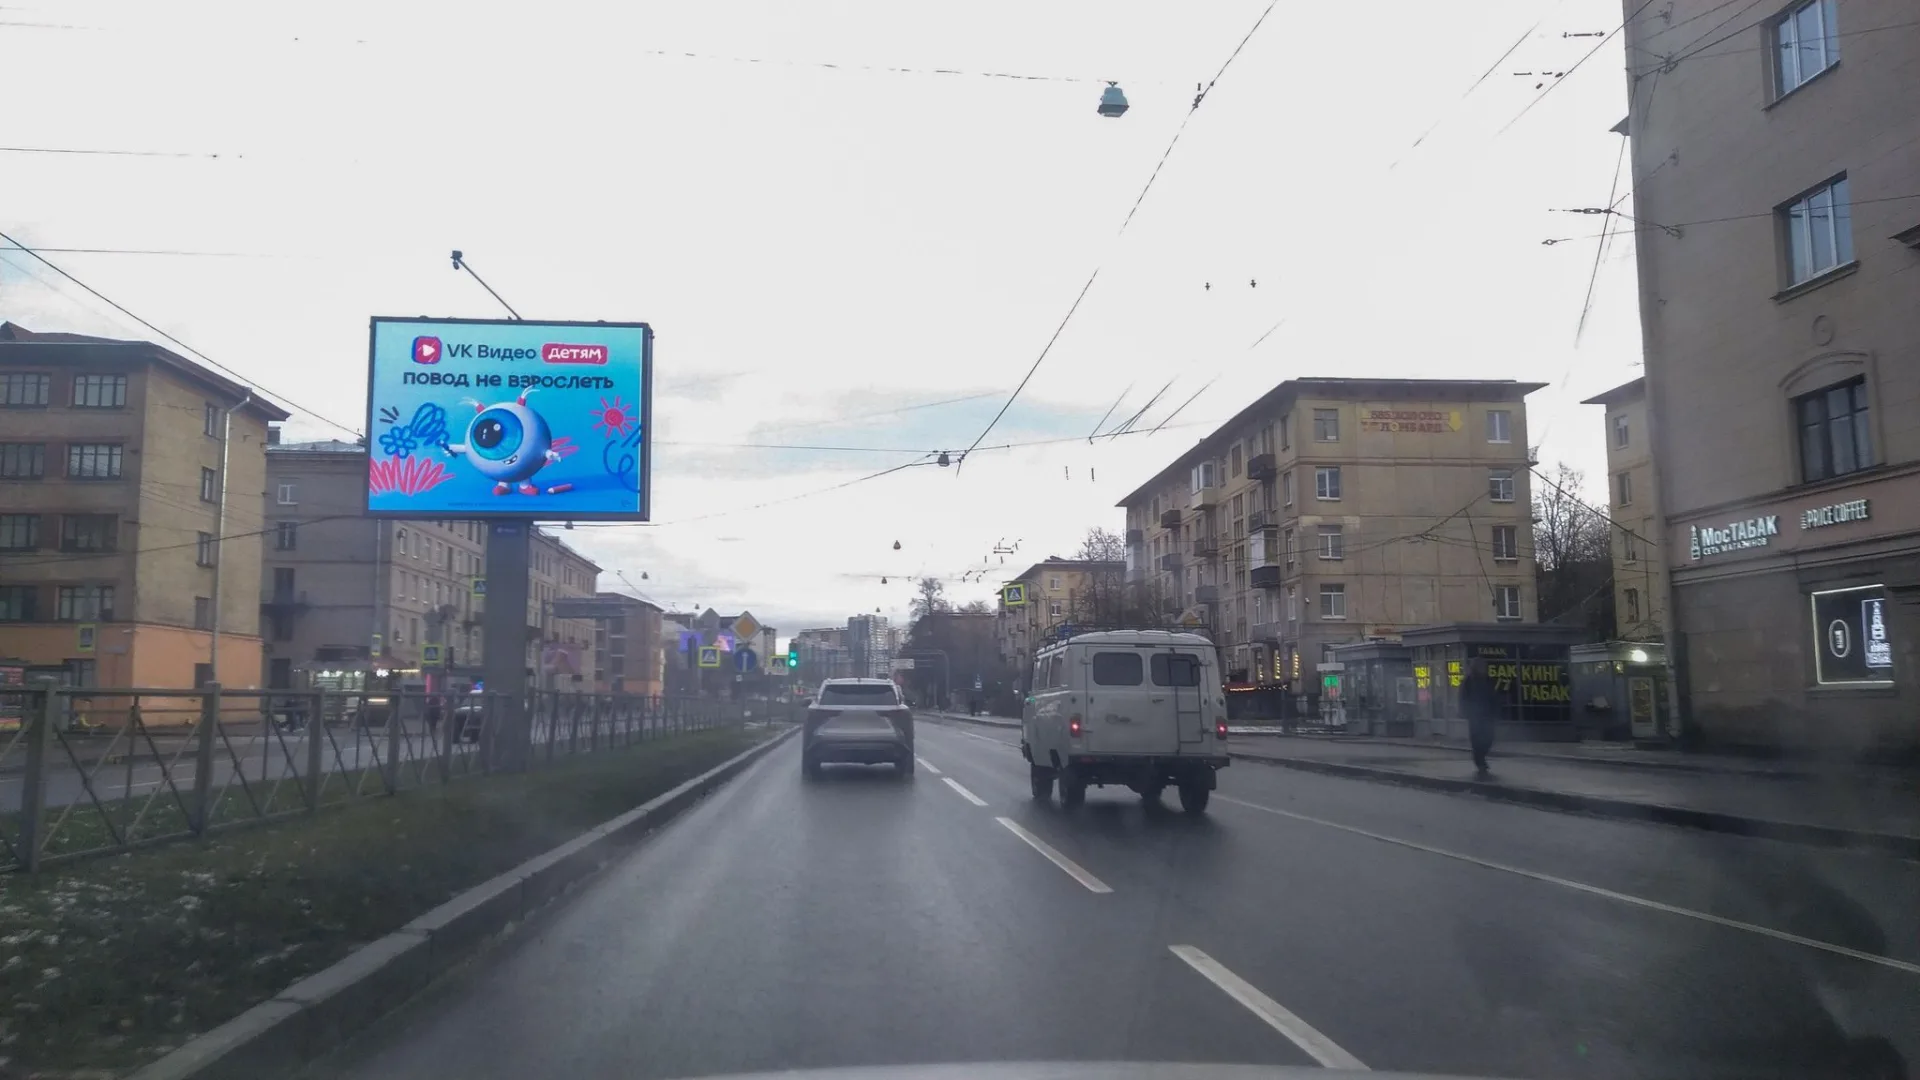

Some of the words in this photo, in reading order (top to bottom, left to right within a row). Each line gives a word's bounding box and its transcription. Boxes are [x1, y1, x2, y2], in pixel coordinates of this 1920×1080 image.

[447, 343, 473, 358] VK
[477, 344, 537, 362] Видео
[547, 347, 602, 363] детям
[403, 371, 470, 387] повод
[475, 374, 502, 387] не
[508, 374, 614, 390] взрослеть
[1806, 506, 1834, 528] PRICE
[1834, 499, 1869, 523] COFFEE
[1701, 515, 1777, 546] МосТАБАК
[1488, 664, 1517, 677] БАК
[1521, 664, 1562, 681] КИНГ
[1520, 684, 1571, 701] ТАБАК
